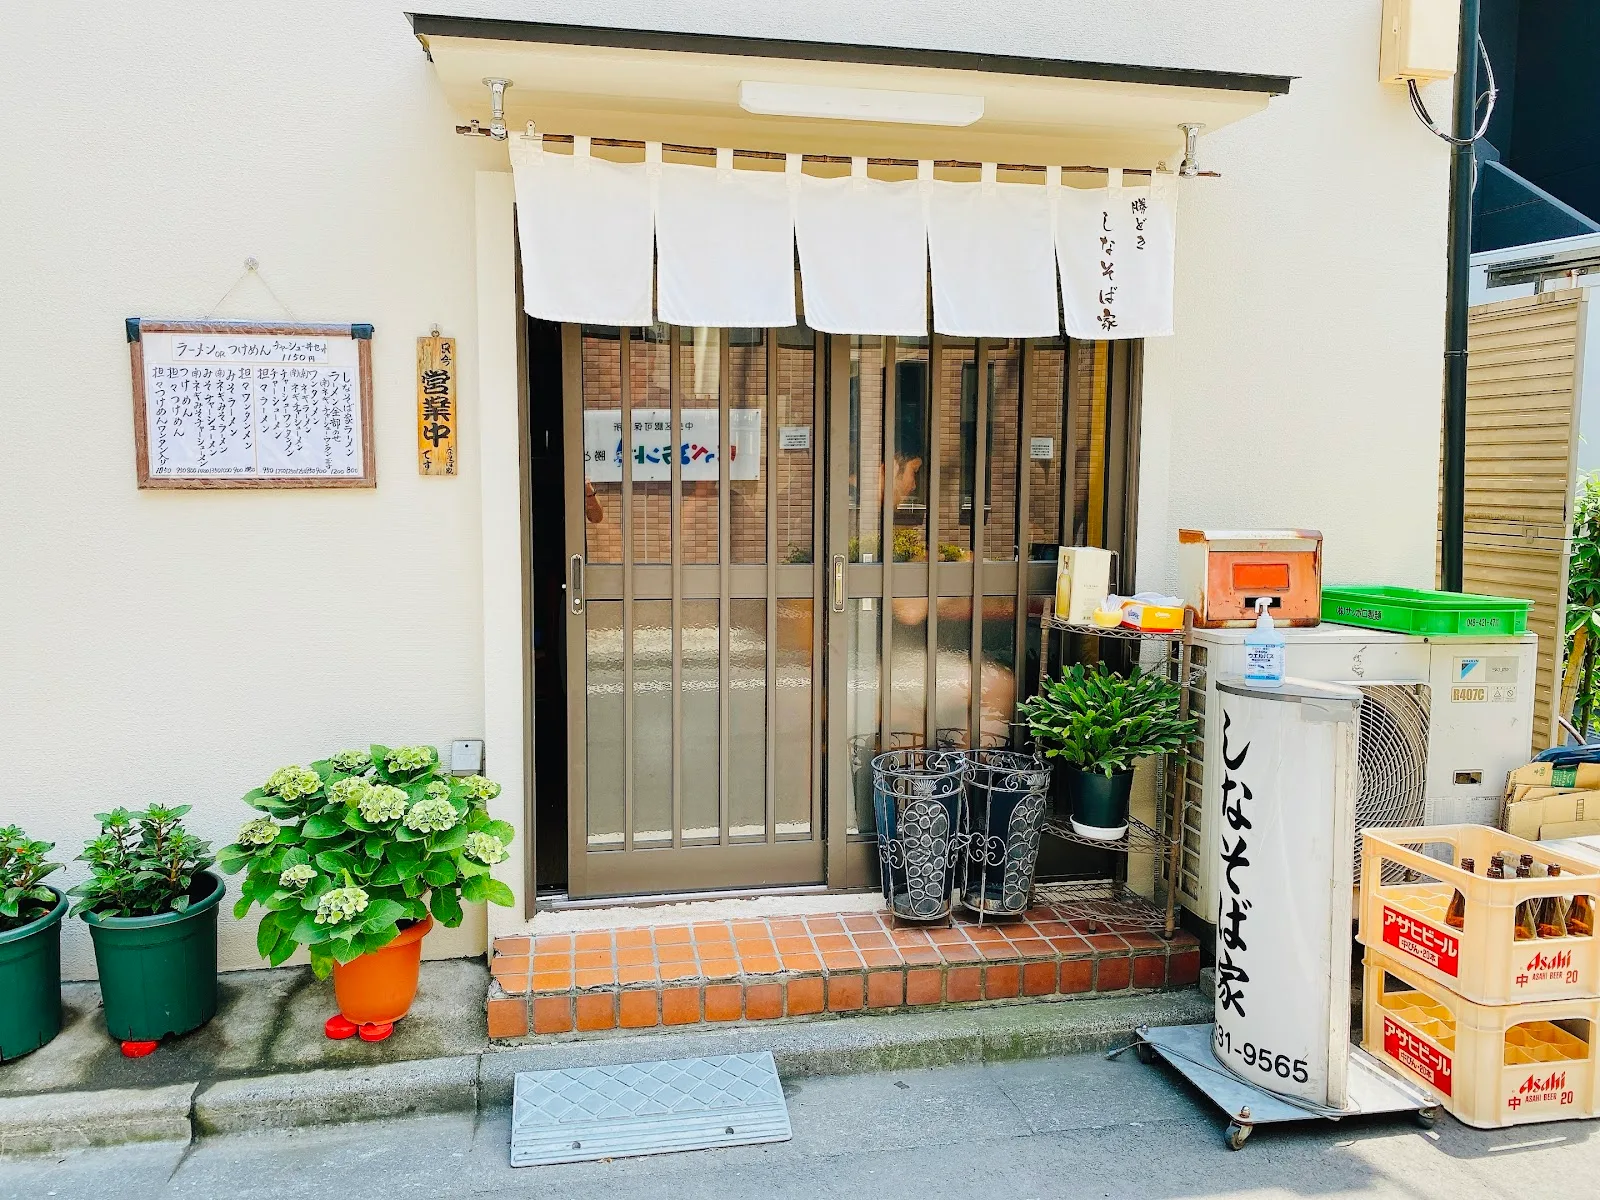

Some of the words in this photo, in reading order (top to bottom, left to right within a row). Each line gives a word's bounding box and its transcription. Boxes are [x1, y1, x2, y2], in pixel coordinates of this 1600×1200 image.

[1132, 198, 1148, 250] 勝どき
[1097, 211, 1118, 331] しなそば家
[176, 342, 216, 357] ラーメン
[228, 343, 272, 357] つけめん
[180, 367, 193, 418] つけめん
[421, 369, 451, 448] 営業中
[422, 450, 432, 470] です
[1453, 688, 1485, 702] R407C
[1218, 708, 1253, 1018] しなそば家
[1384, 908, 1459, 958] アサヒビール
[1516, 973, 1529, 988] 中
[1531, 972, 1548, 981] ASAHI
[1549, 971, 1563, 980] BEER
[1565, 969, 1579, 984] 20
[1526, 949, 1573, 972] Asahi
[1384, 1019, 1451, 1077] アサヒビール
[1508, 1096, 1521, 1111] 中
[1525, 1094, 1542, 1103] ASAHI
[1543, 1093, 1557, 1101] BEER
[1560, 1090, 1574, 1105] 20
[1519, 1071, 1567, 1094] Asahi
